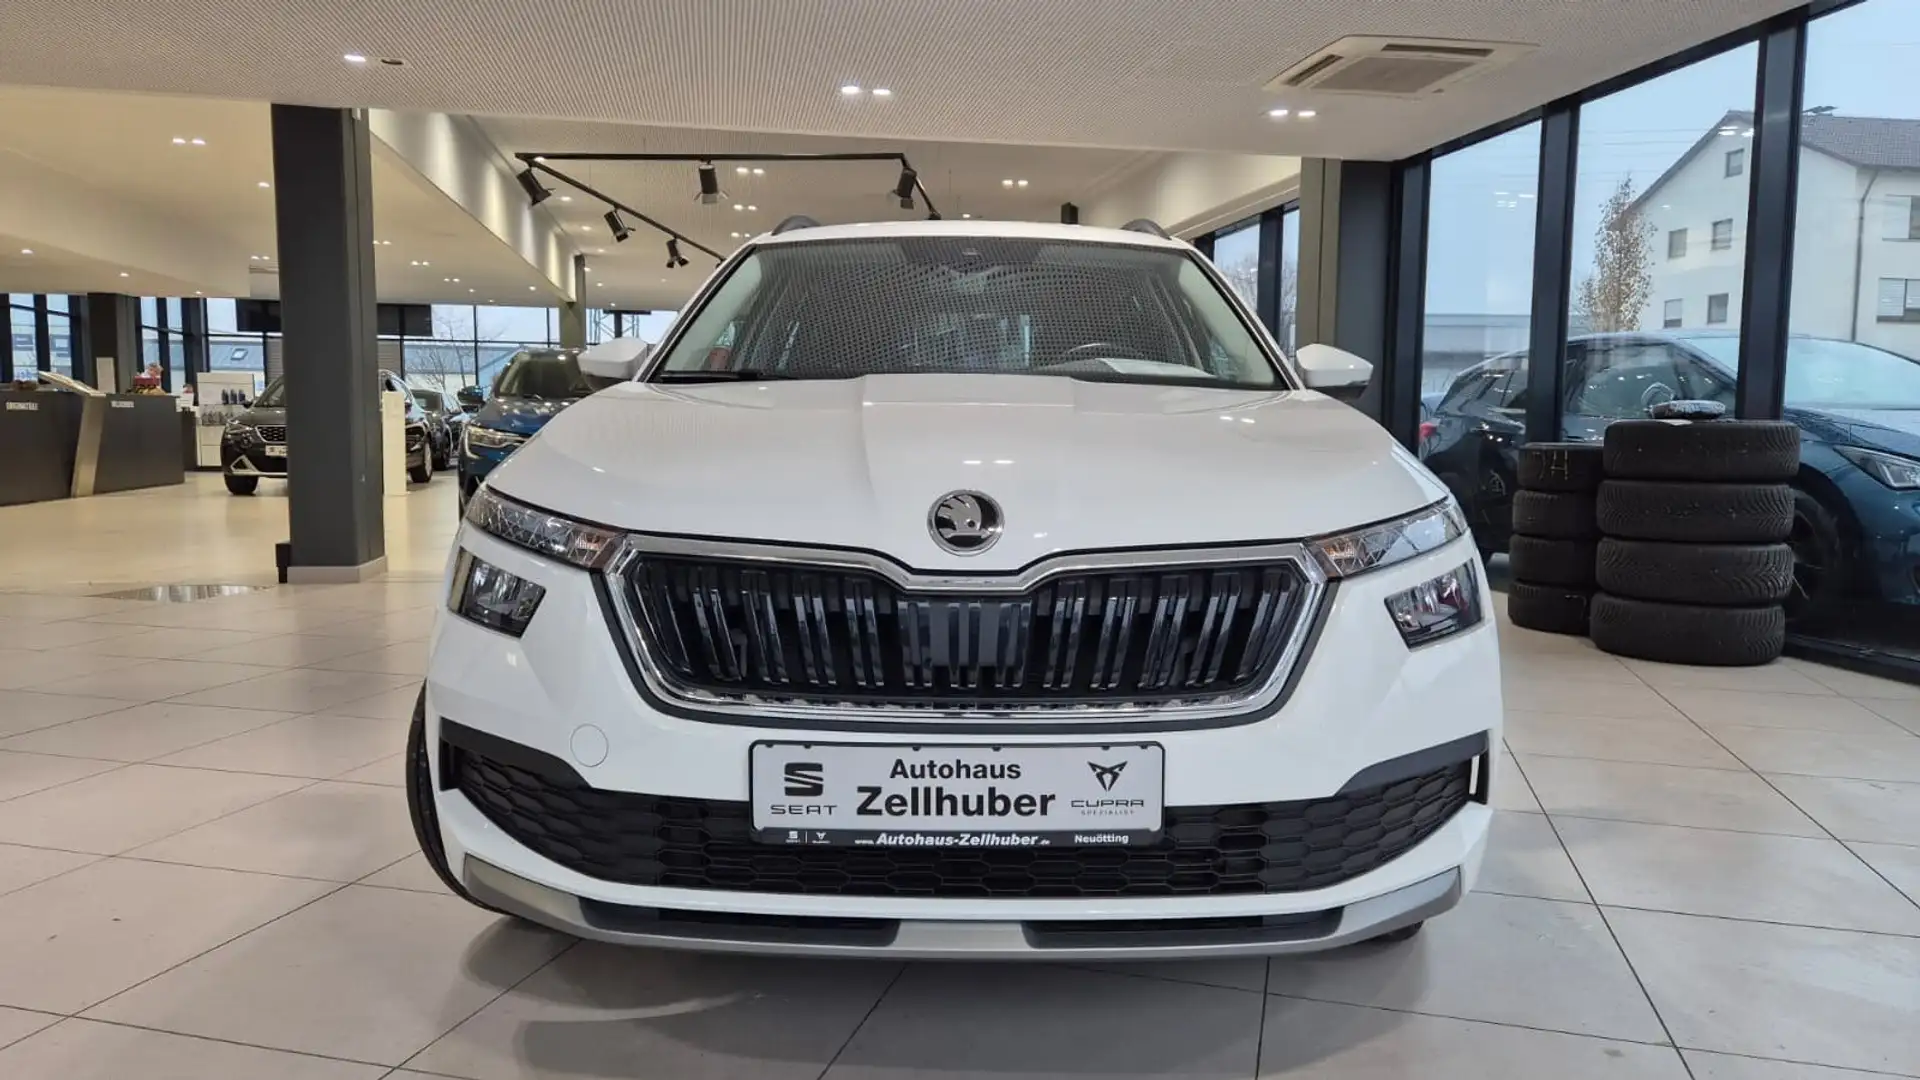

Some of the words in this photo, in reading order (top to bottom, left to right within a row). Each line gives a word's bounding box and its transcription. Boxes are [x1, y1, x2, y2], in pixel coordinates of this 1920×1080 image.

[889, 758, 1022, 779] Autohaus
[856, 786, 1056, 816] Zellhuber
[1071, 799, 1144, 808] CUPRA
[770, 804, 838, 815] SEAT
[1074, 833, 1130, 845] Neuötting
